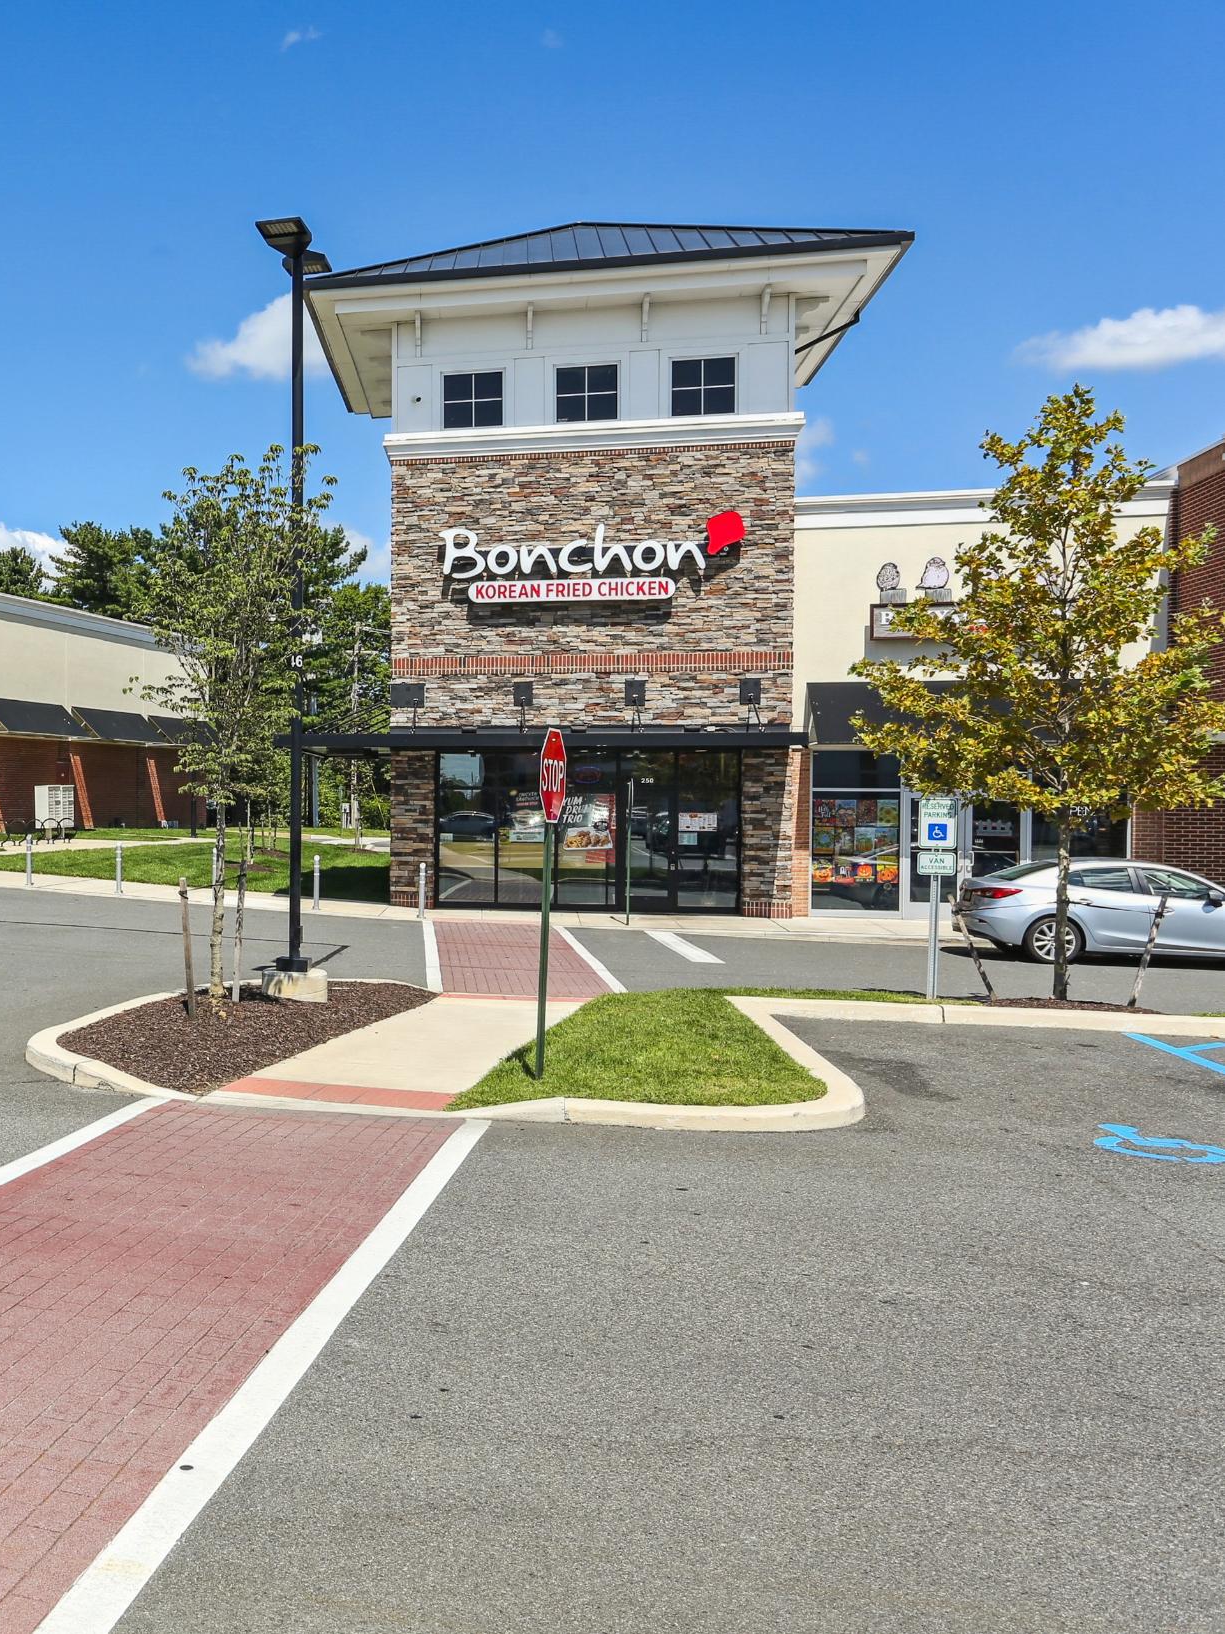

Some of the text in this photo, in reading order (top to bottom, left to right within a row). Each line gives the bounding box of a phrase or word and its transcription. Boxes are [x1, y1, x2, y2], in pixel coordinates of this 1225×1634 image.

[439, 523, 706, 579] Bonchon
[475, 580, 669, 600] KOREAN FRIED CHICKEN
[542, 757, 565, 793] STOP
[921, 801, 955, 810] RESERVED
[1069, 805, 1091, 816] PEN
[562, 813, 583, 824] TRIO
[923, 811, 952, 819] PARKING
